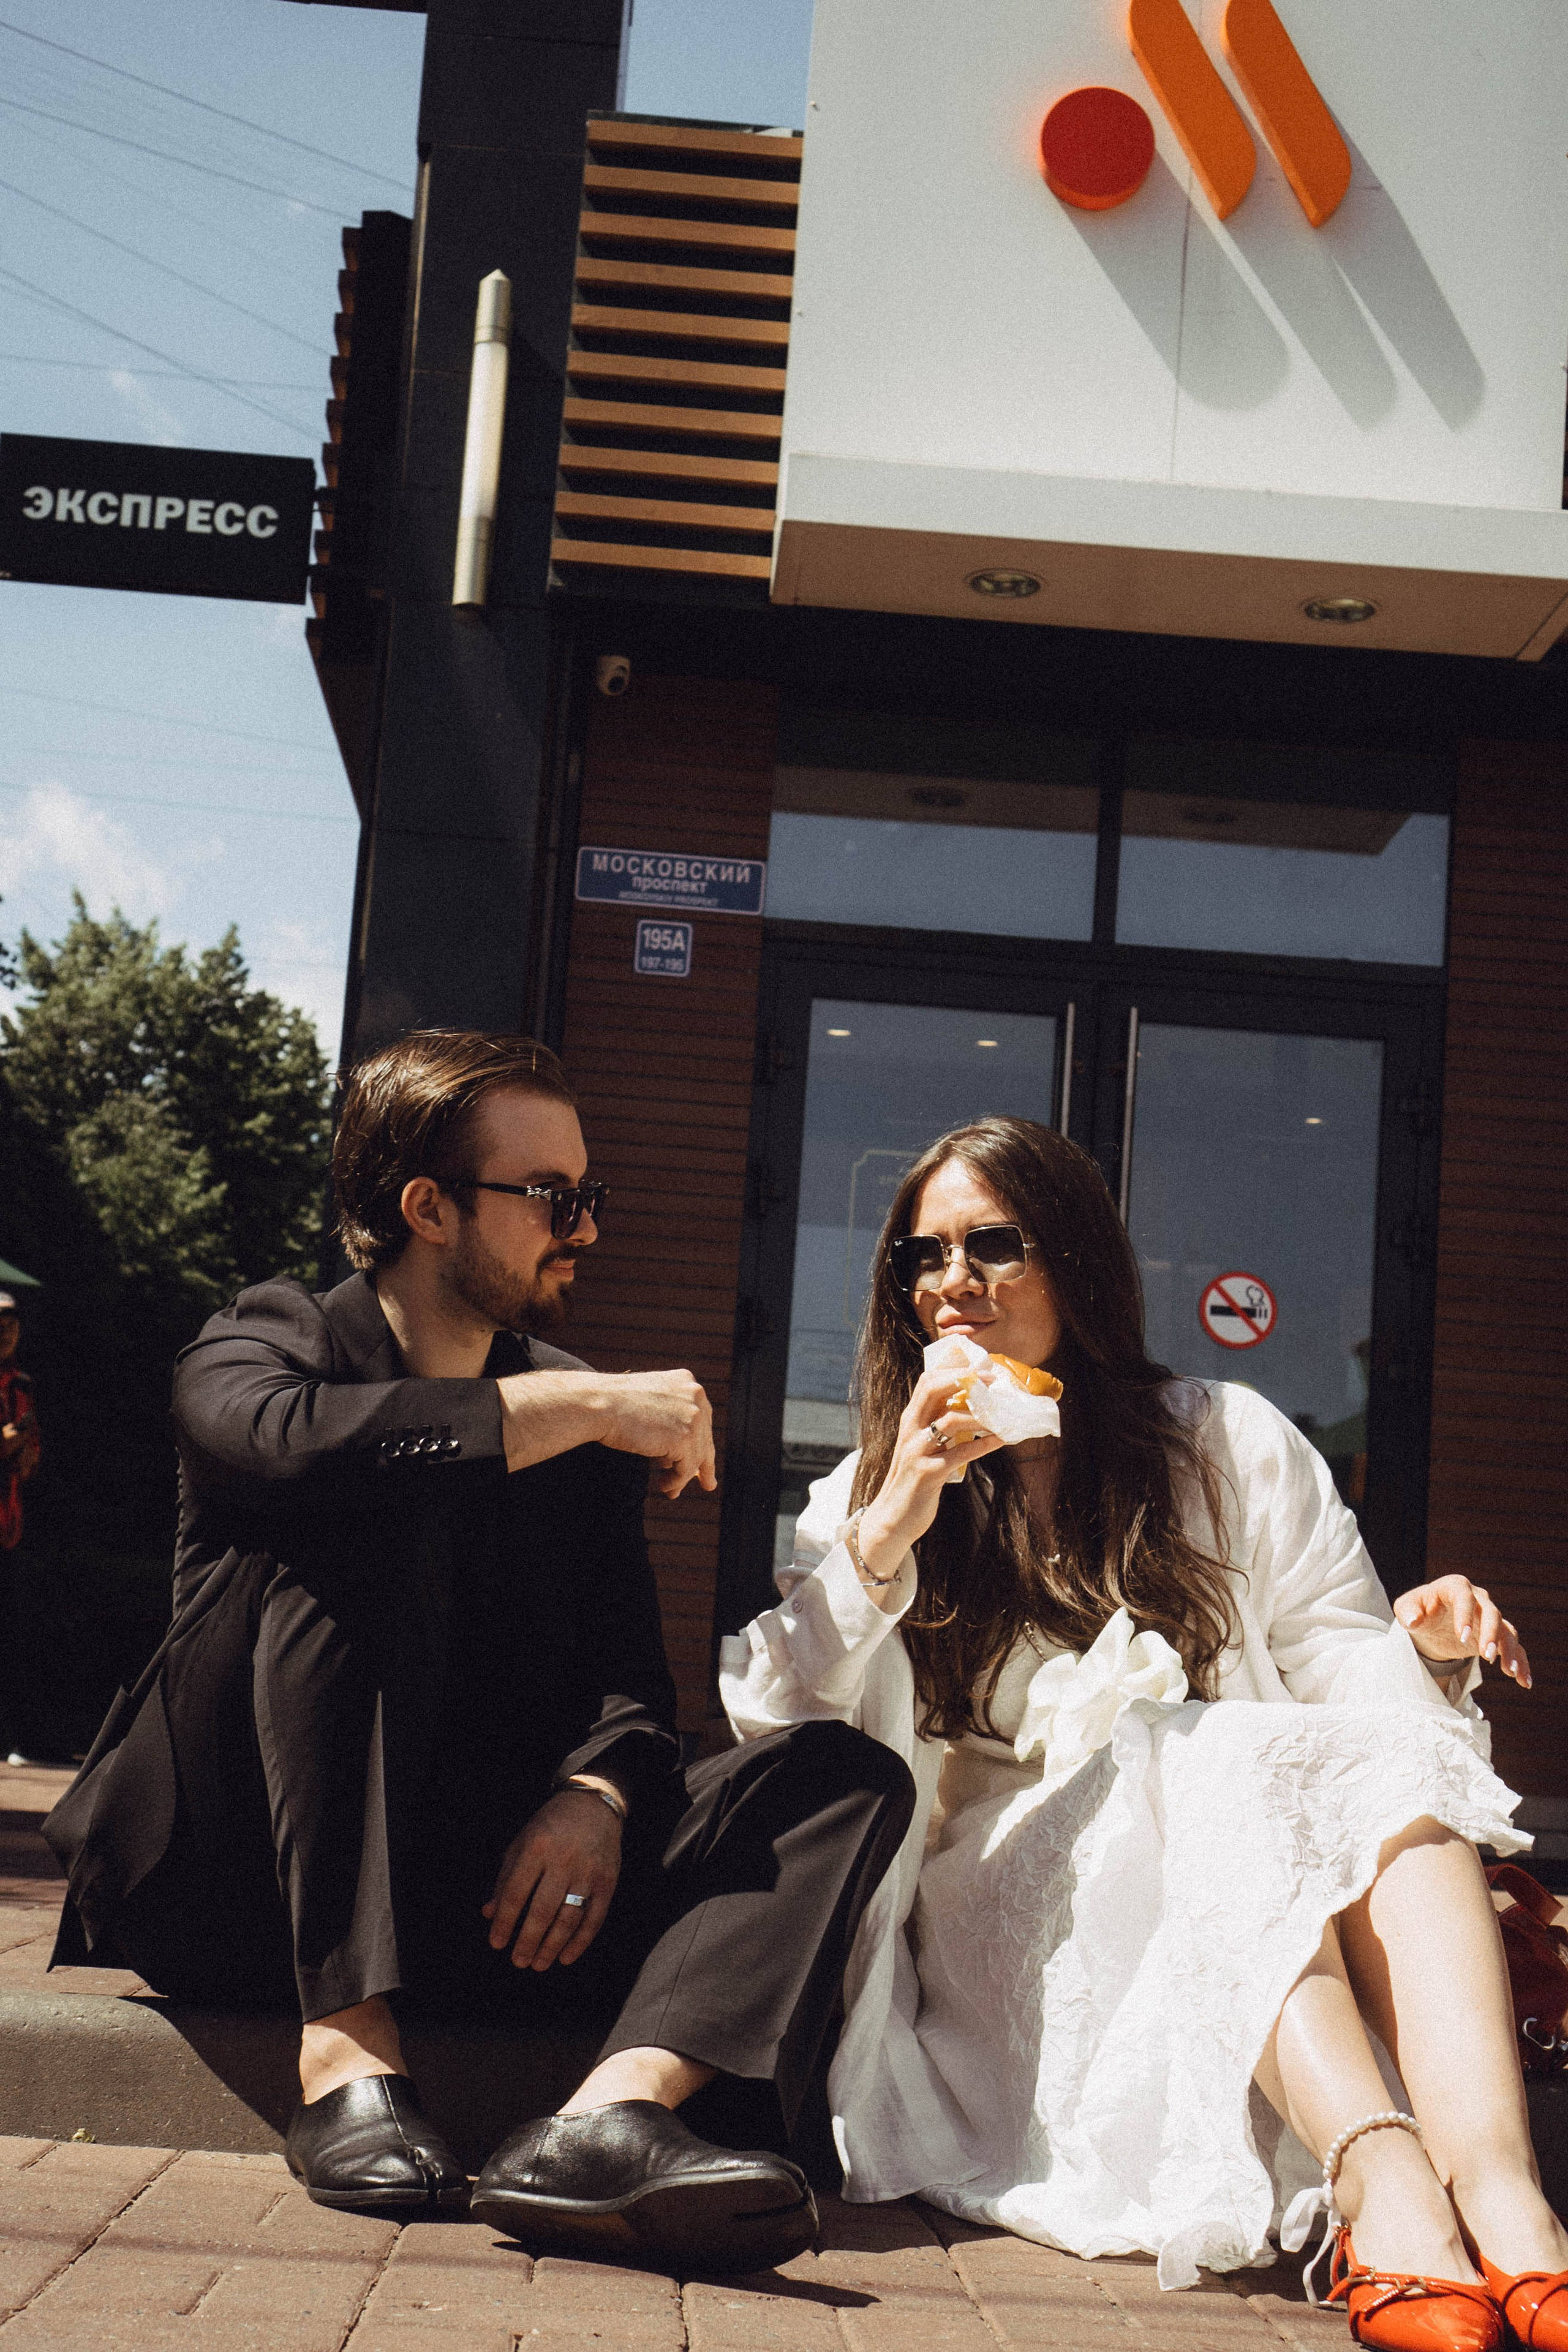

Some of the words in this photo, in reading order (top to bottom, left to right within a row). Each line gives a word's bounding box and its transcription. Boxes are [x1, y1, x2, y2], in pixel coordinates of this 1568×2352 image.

[22, 486, 279, 538] ЭКСПРЕСС
[593, 854, 751, 883] МОСКОВСКИЙ
[631, 876, 708, 894] проспект
